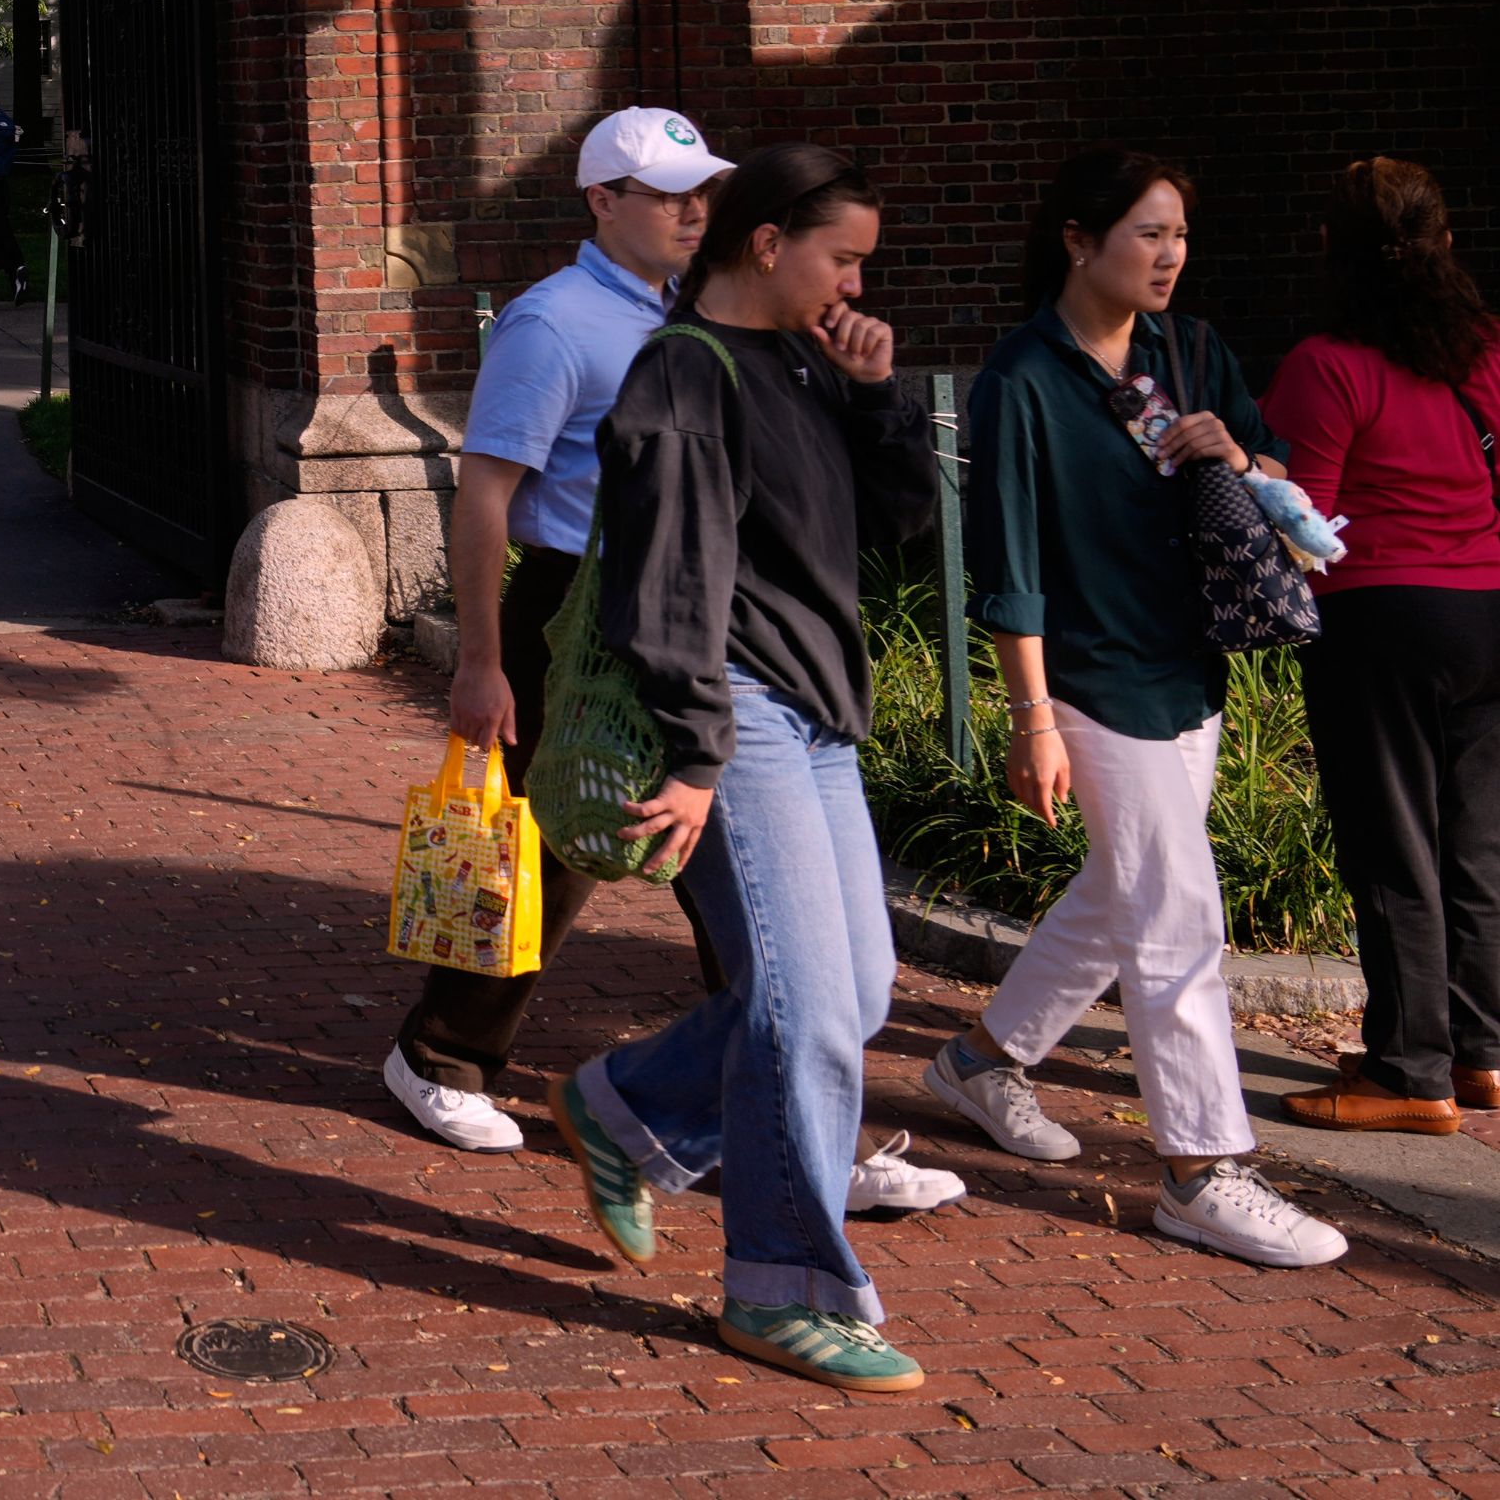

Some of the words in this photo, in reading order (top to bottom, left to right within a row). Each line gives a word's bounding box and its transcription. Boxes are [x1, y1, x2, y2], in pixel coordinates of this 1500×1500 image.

[1223, 542, 1256, 561] MK
[1255, 556, 1281, 578] MK
[1213, 603, 1245, 621] MK
[1266, 595, 1293, 617] MK
[1244, 621, 1277, 638] MK
